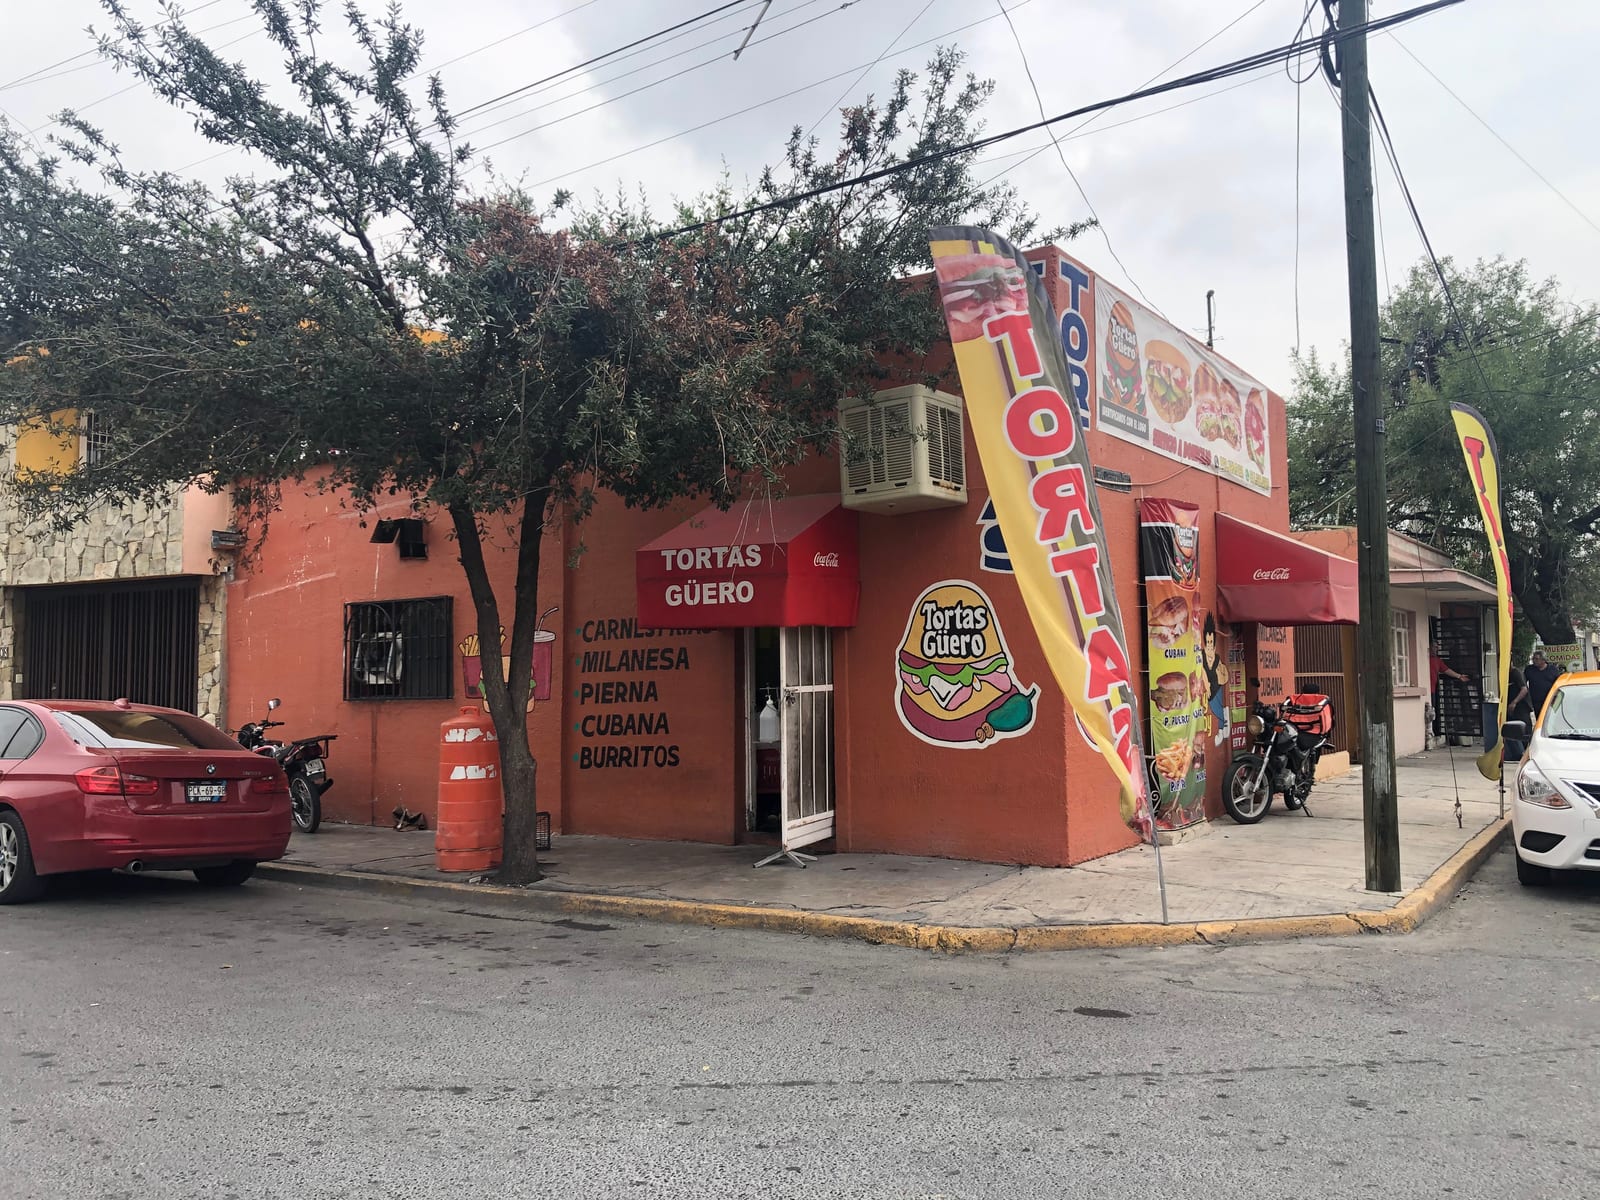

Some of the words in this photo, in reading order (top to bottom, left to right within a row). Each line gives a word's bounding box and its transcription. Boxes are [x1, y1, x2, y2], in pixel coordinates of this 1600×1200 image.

[1110, 316, 1137, 345] Tortas
[1059, 256, 1091, 431] TOR
[1113, 335, 1136, 360] Güero
[661, 544, 762, 571] TORTAS
[1253, 567, 1290, 581] Coca-Cola
[665, 580, 755, 606] GÜERO
[921, 601, 987, 630] Tortas
[922, 630, 985, 657] Güero
[1164, 648, 1187, 659] CUBAN
[1538, 644, 1580, 653] MUERZOS
[581, 647, 690, 673] MILANESA
[1259, 650, 1281, 670] PIERNA
[1547, 653, 1580, 662] OMIDAS
[580, 680, 658, 705] PIERNA
[581, 712, 670, 737] CUBANA
[580, 745, 680, 769] BURRITOS
